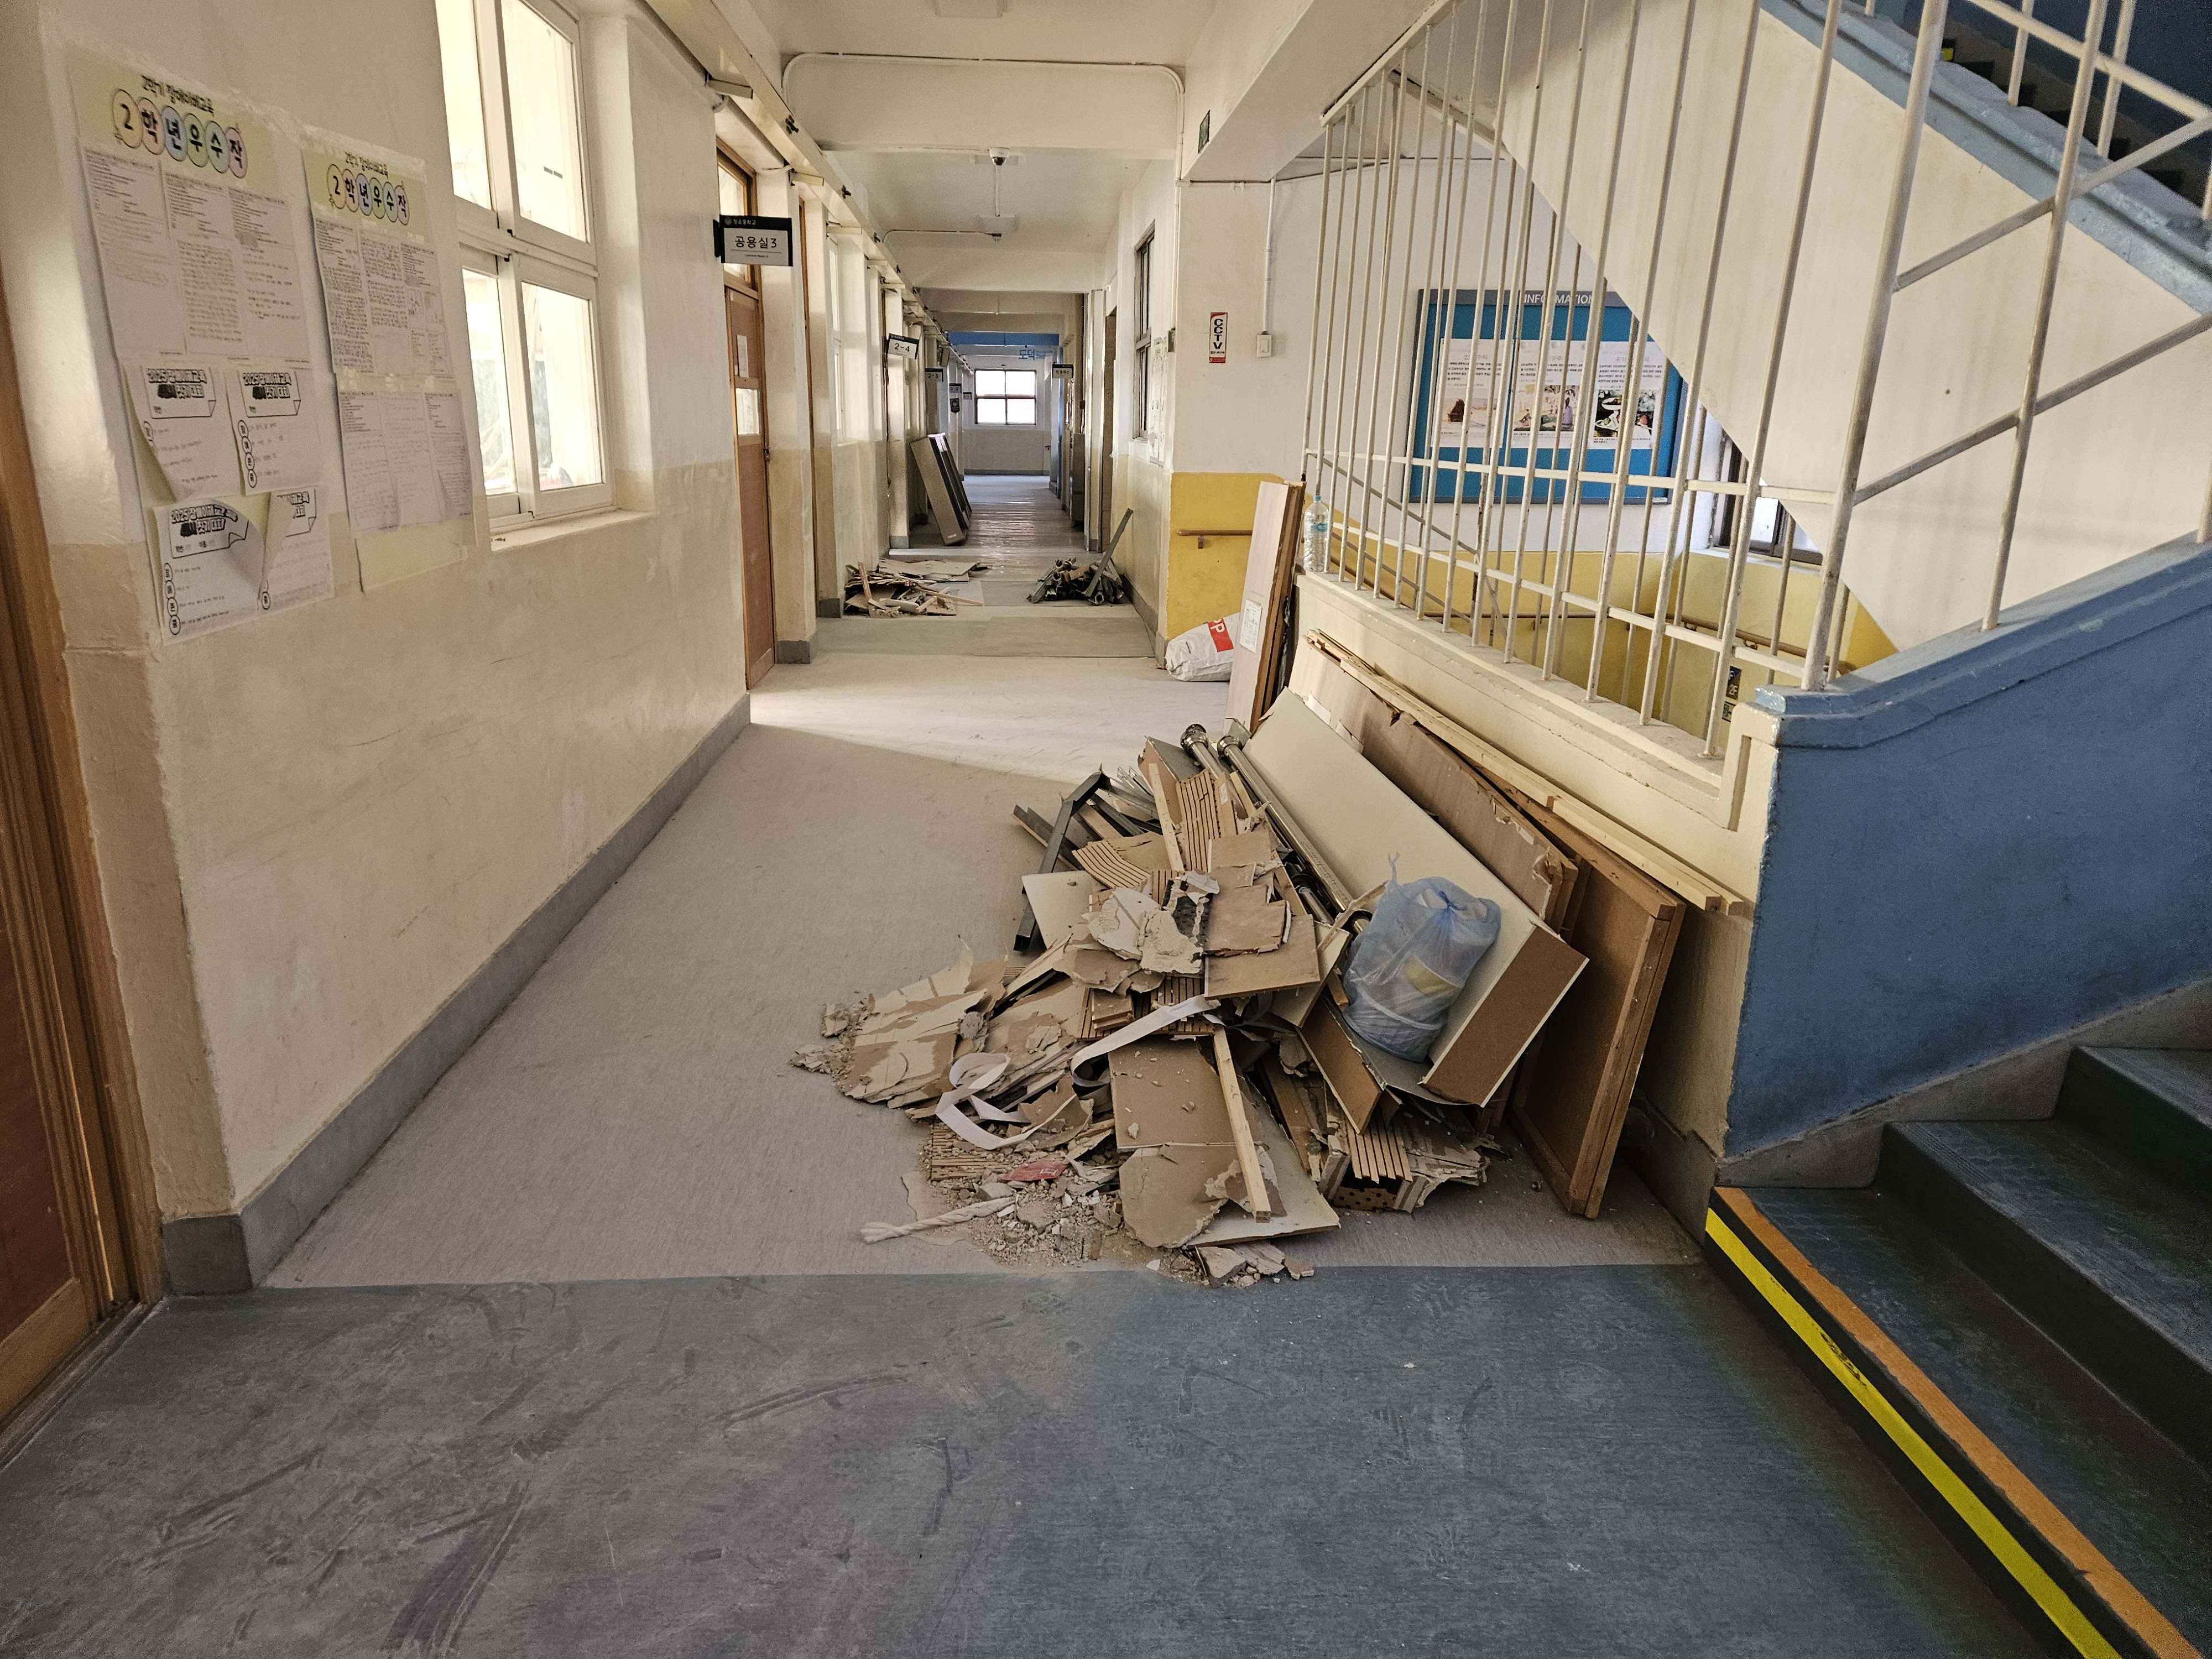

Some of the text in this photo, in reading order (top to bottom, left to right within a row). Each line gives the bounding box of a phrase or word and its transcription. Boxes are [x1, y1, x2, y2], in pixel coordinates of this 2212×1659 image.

[1524, 294, 1593, 304] INFMAIO
[1213, 319, 1223, 349] CCTV
[894, 343, 910, 352] 2-4
[1019, 349, 1035, 360] 도덕
[171, 509, 187, 524] 2025
